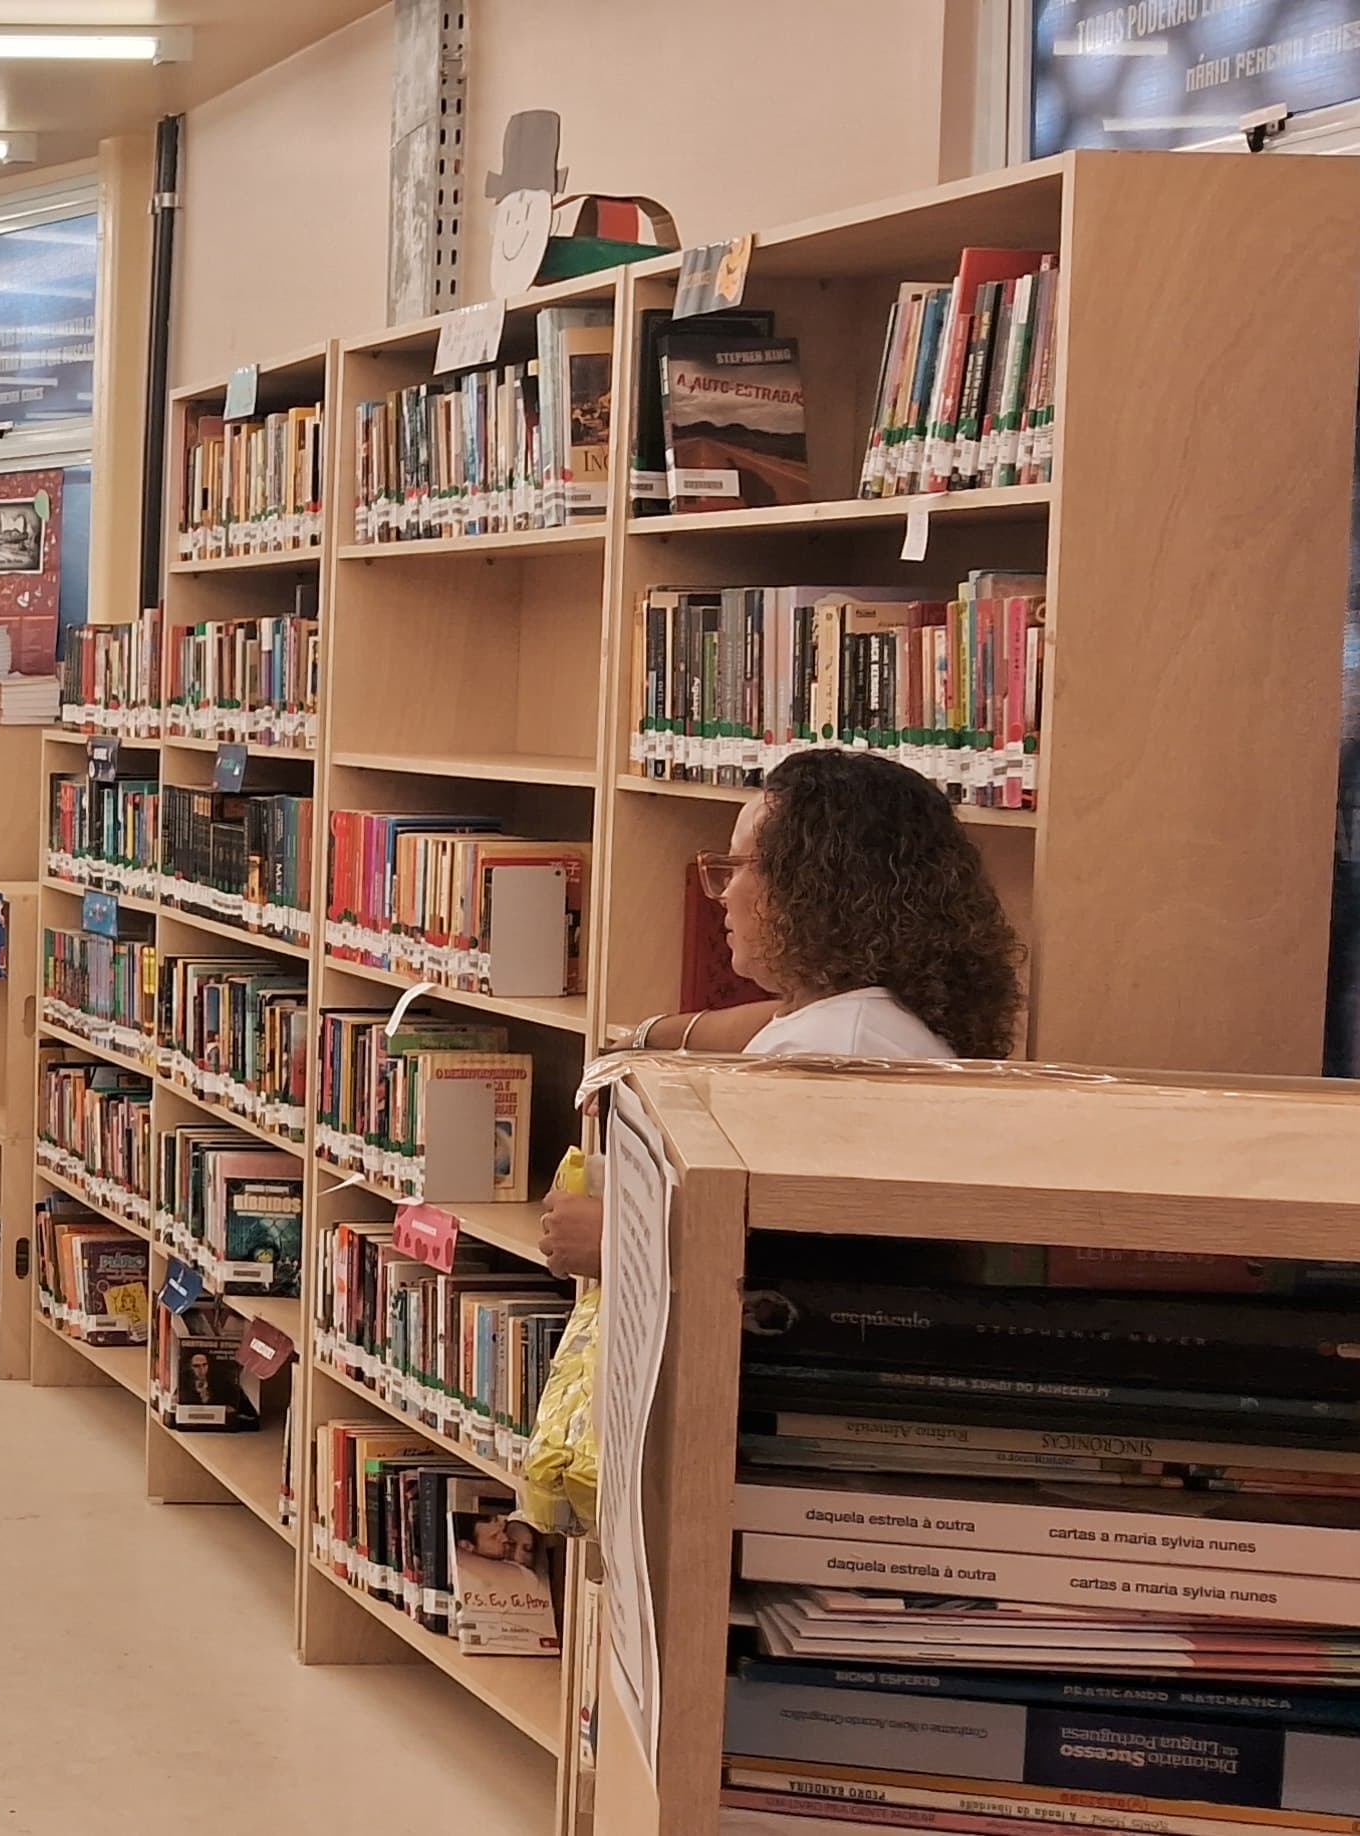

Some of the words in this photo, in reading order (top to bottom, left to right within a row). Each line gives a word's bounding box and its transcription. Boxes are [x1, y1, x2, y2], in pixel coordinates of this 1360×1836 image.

[1186, 54, 1229, 93] MÁRIO
[716, 351, 763, 364] STEPHEN
[830, 1310, 933, 1343] crepúsculo
[1015, 1382, 1035, 1393] DO
[1036, 1383, 1112, 1399] MINECRAFT
[805, 1508, 866, 1527] daquela
[868, 1514, 919, 1530] estrela
[923, 1516, 933, 1531] à
[935, 1518, 977, 1533] outra
[1048, 1526, 1097, 1542] cartas
[1100, 1531, 1110, 1542] a
[1114, 1531, 1158, 1547] maria
[1160, 1534, 1206, 1553] sylvia
[1208, 1540, 1257, 1554] nunes
[826, 1557, 888, 1575] daquela
[889, 1563, 940, 1579] estrela
[943, 1565, 954, 1580] à
[956, 1568, 997, 1583] outra
[1070, 1575, 1118, 1592] cartas
[1121, 1581, 1131, 1593] a
[1135, 1581, 1179, 1598] maria
[1182, 1584, 1227, 1602] sylvia
[1229, 1589, 1278, 1604] nunes
[464, 1592, 488, 1607] P.S.
[1061, 1727, 1158, 1750] Portuguesa
[1060, 1743, 1146, 1768] Sucesso
[1149, 1752, 1239, 1774] Dicionário
[789, 1781, 845, 1797] BANDEIRA
[848, 1788, 886, 1802] PEDRO
